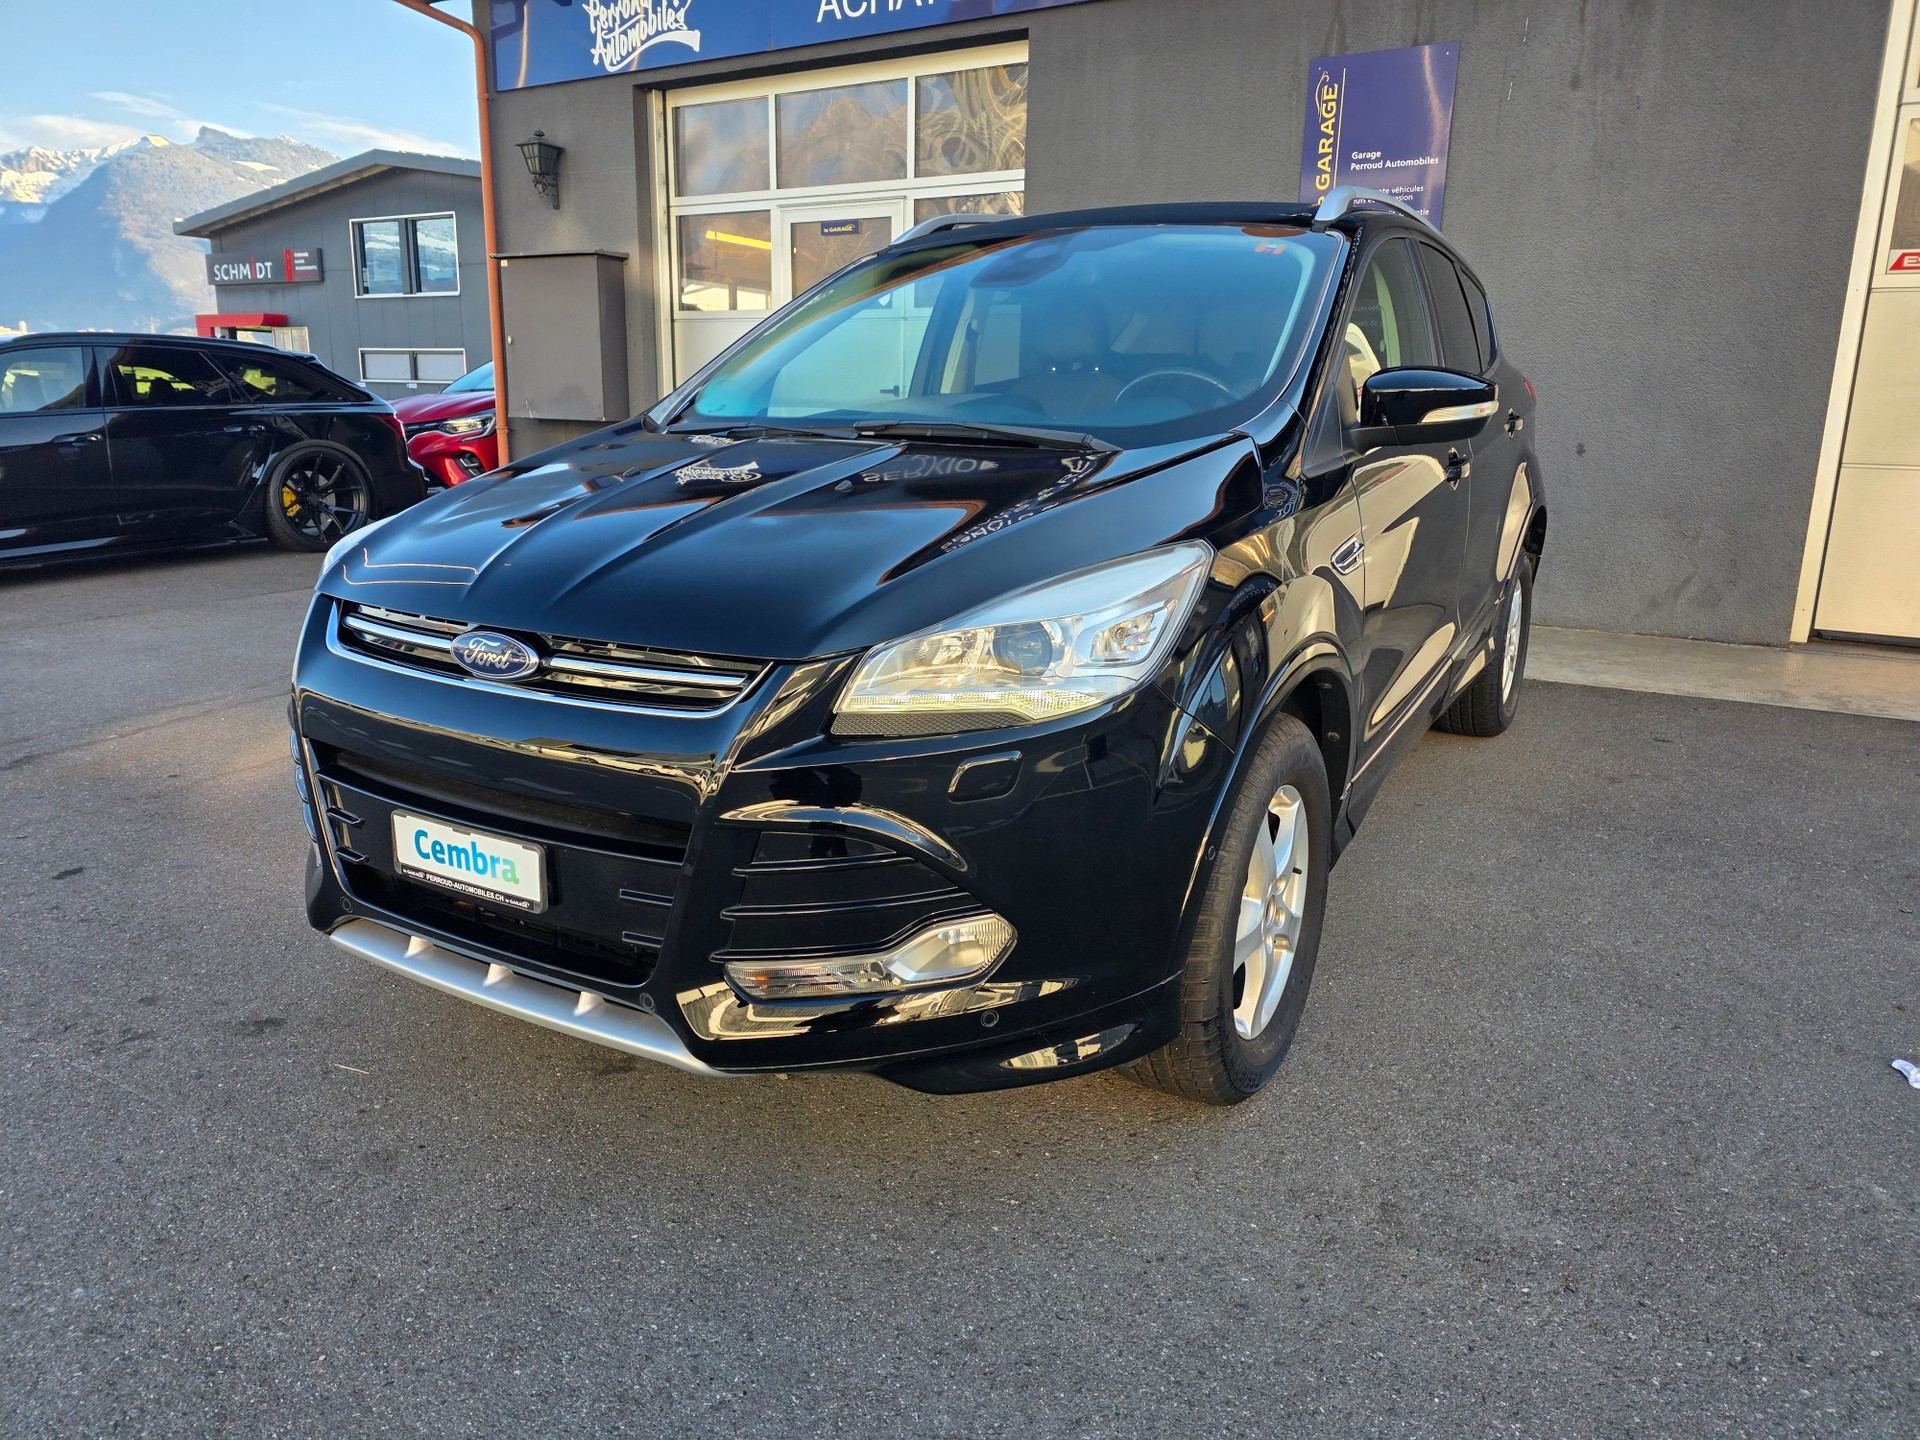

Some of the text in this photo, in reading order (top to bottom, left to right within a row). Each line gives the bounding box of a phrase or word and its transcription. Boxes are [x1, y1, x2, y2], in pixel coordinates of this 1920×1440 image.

[1315, 83, 1339, 190] GARAGE
[1350, 157, 1439, 171] Perroud Automobiles
[1351, 151, 1382, 160] Garage
[1391, 185, 1424, 194] véhicules
[463, 637, 511, 670] Ford
[414, 829, 520, 885] Cembra
[425, 873, 505, 902] PERROUD-AUTOMOBILES.CH
